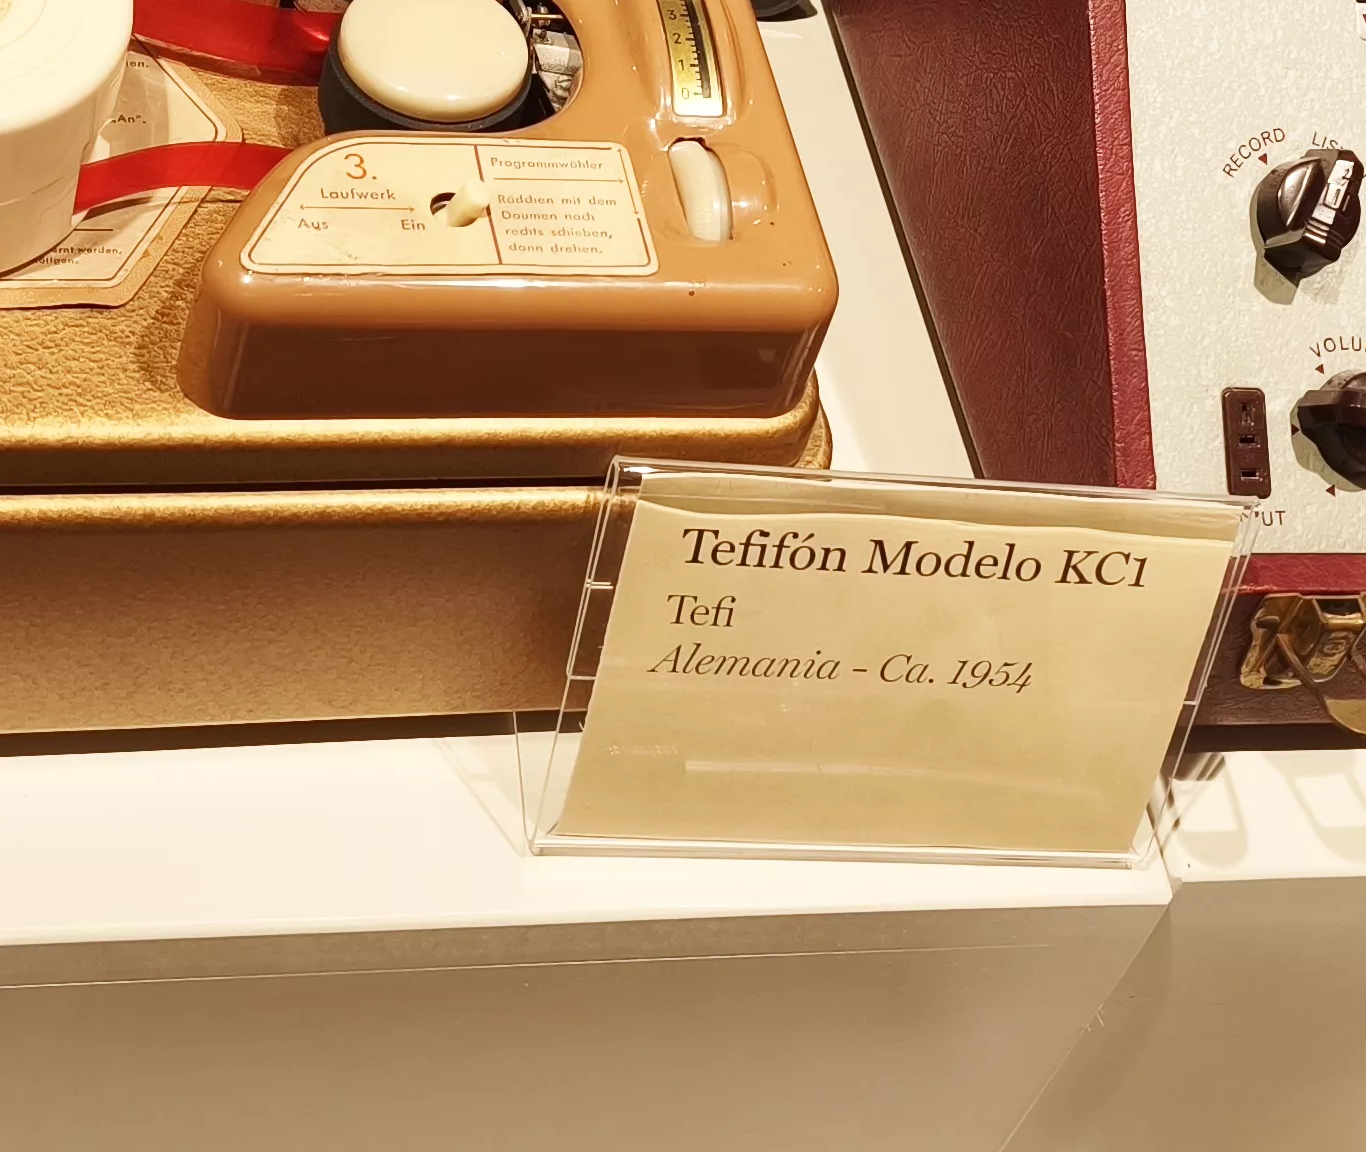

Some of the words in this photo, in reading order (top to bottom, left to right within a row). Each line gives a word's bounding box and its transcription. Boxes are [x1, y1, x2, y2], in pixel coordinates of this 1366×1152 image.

[668, 9, 678, 21] 3
[672, 32, 682, 44] 2
[678, 59, 685, 70] 1
[1222, 127, 1287, 178] RECORD
[344, 153, 378, 180] 3.
[490, 156, 604, 173] Programmwähler
[320, 187, 396, 202] Laufwerk
[561, 195, 583, 206] mit
[588, 196, 618, 206] dem
[501, 210, 558, 222] Daumen
[564, 211, 595, 222] nach
[297, 218, 329, 231] Aus
[400, 219, 426, 231] Ein
[505, 227, 544, 238] rechts
[509, 243, 544, 253] dann
[550, 244, 603, 254] drehen.
[681, 528, 847, 574] Tefifón
[861, 539, 1042, 582] Modelo
[1055, 549, 1150, 587] KC1
[667, 594, 736, 628] Tefi
[646, 644, 840, 681] Alemania
[878, 652, 935, 686] Ca.
[947, 659, 1034, 693] 1954
